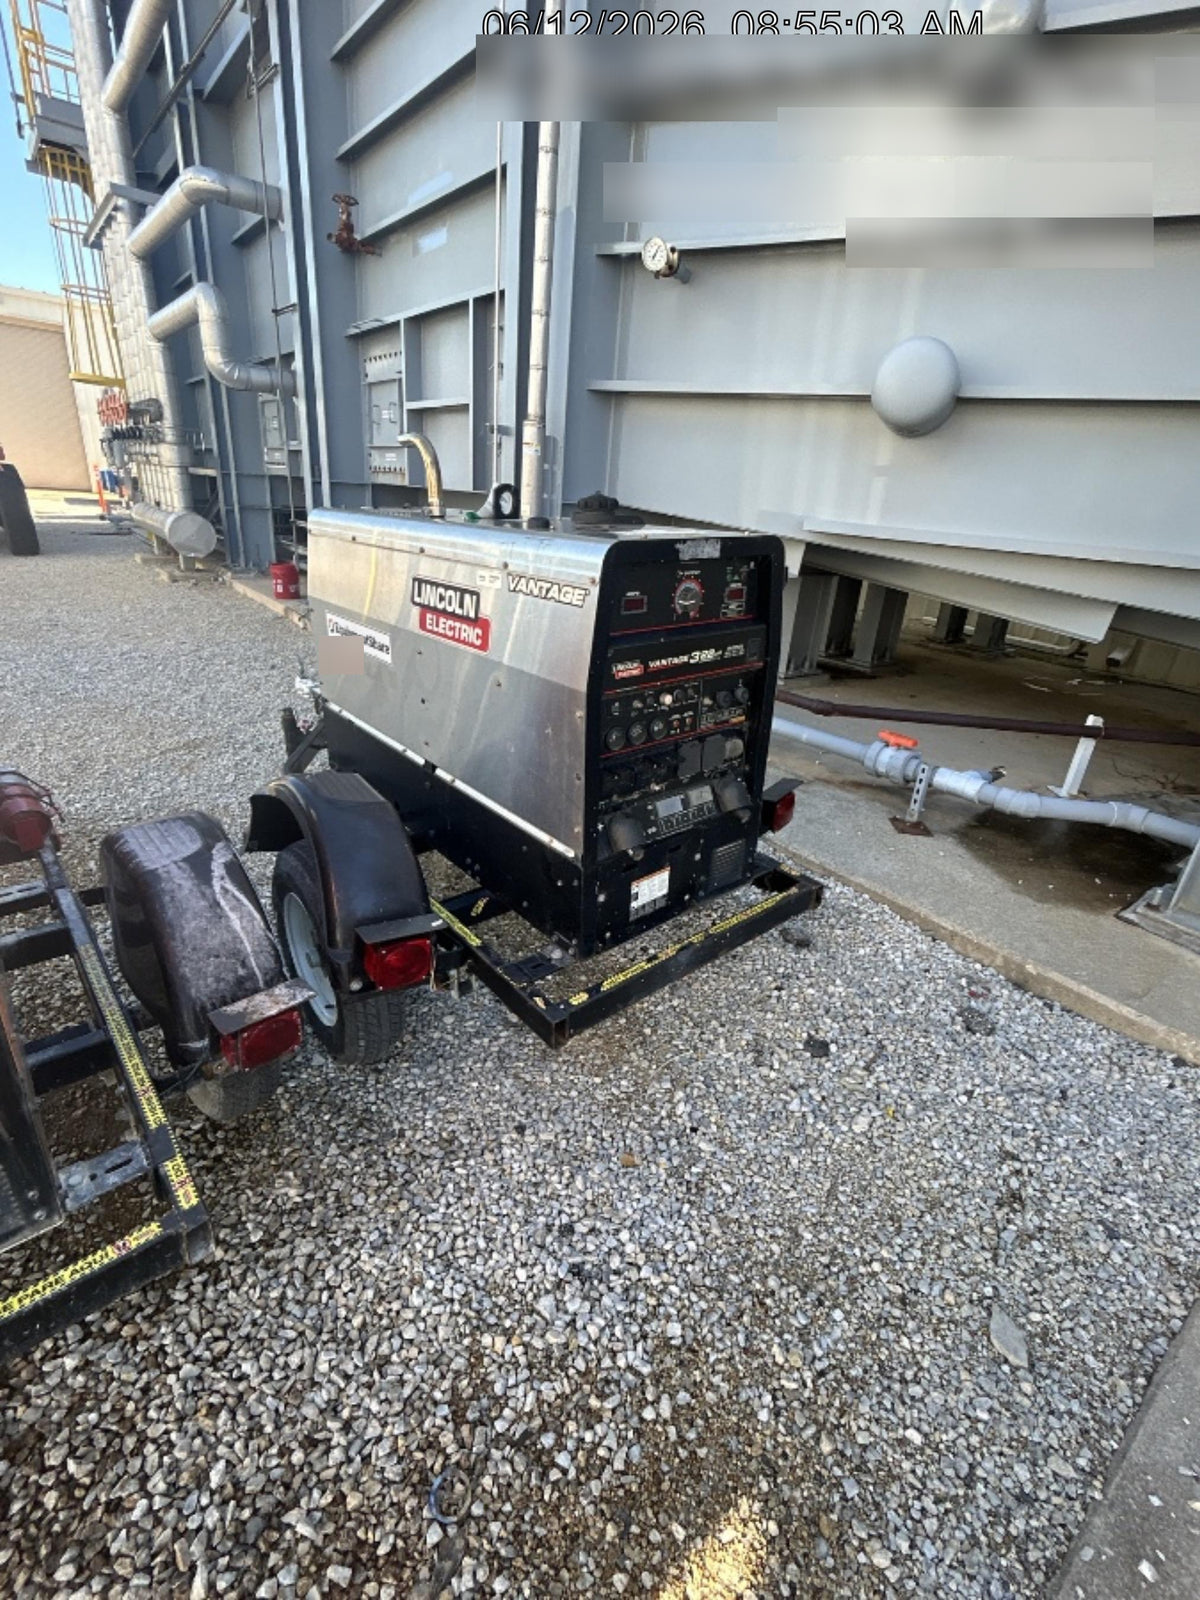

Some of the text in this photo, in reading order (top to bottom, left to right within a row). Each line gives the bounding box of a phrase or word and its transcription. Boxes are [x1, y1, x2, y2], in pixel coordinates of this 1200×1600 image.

[413, 580, 477, 619] LINCOLN
[507, 573, 584, 608] VANTAGE
[425, 612, 483, 646] ELECTRIC
